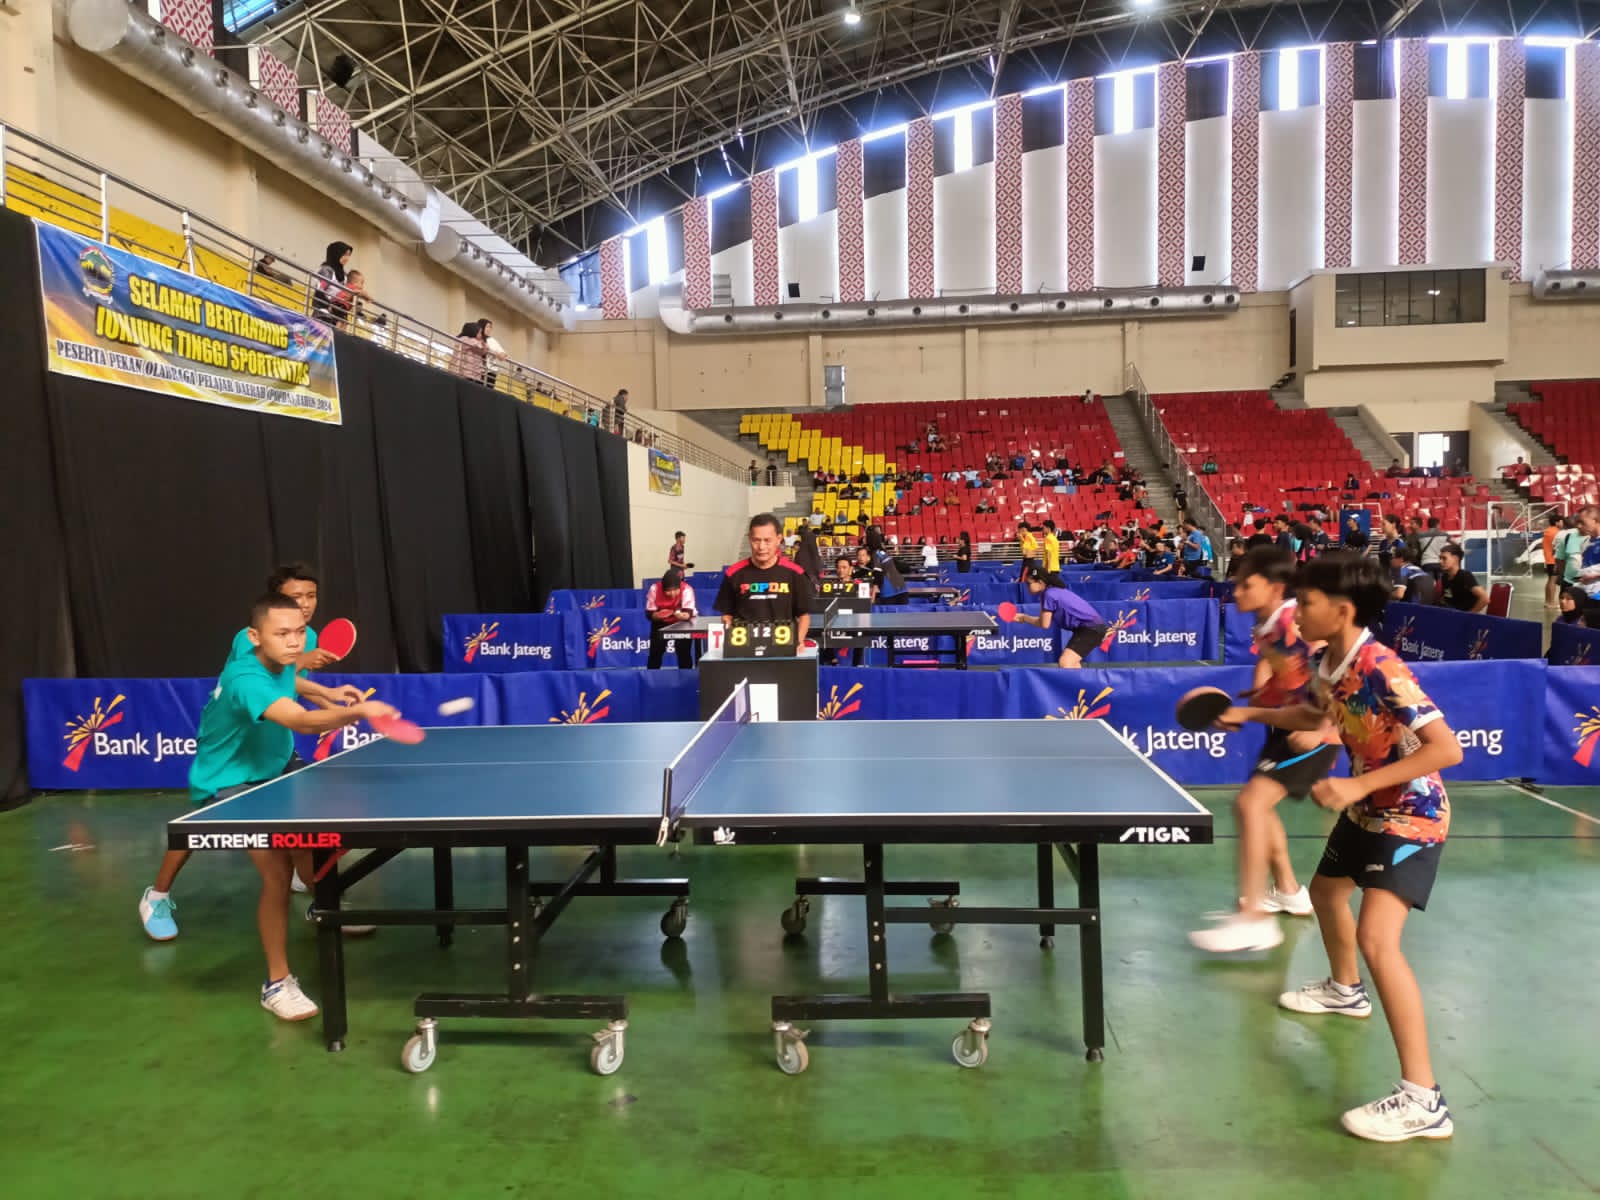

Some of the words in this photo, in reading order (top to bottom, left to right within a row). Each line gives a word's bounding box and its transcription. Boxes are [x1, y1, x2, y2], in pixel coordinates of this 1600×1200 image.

[129, 274, 202, 324] SELAMAT
[205, 300, 288, 349] BERTANDING
[176, 329, 228, 367] TINGGI
[230, 344, 310, 386] SPORTIVITAS
[57, 339, 106, 365] PESERTA
[109, 353, 143, 376] PEKAN
[199, 374, 233, 396] PELAJAR
[740, 582, 790, 595] POPDA
[602, 636, 633, 650] Bank
[712, 630, 723, 649] T
[731, 627, 747, 646] 8
[775, 625, 791, 645] 9
[893, 637, 929, 651] ateng
[977, 636, 1010, 650] Bank
[1011, 635, 1053, 653] Jateng
[1118, 629, 1152, 644] Bank
[1153, 629, 1197, 647] Jateng
[481, 642, 511, 656] Bank
[512, 642, 552, 660] Jateng
[94, 731, 150, 756] Bank
[154, 731, 197, 763] Jate
[1143, 725, 1227, 758] Jateng
[1455, 729, 1504, 756] eng
[188, 833, 269, 849] EXTREME
[271, 832, 342, 848] ROLLER
[1119, 826, 1190, 843] STIGA
